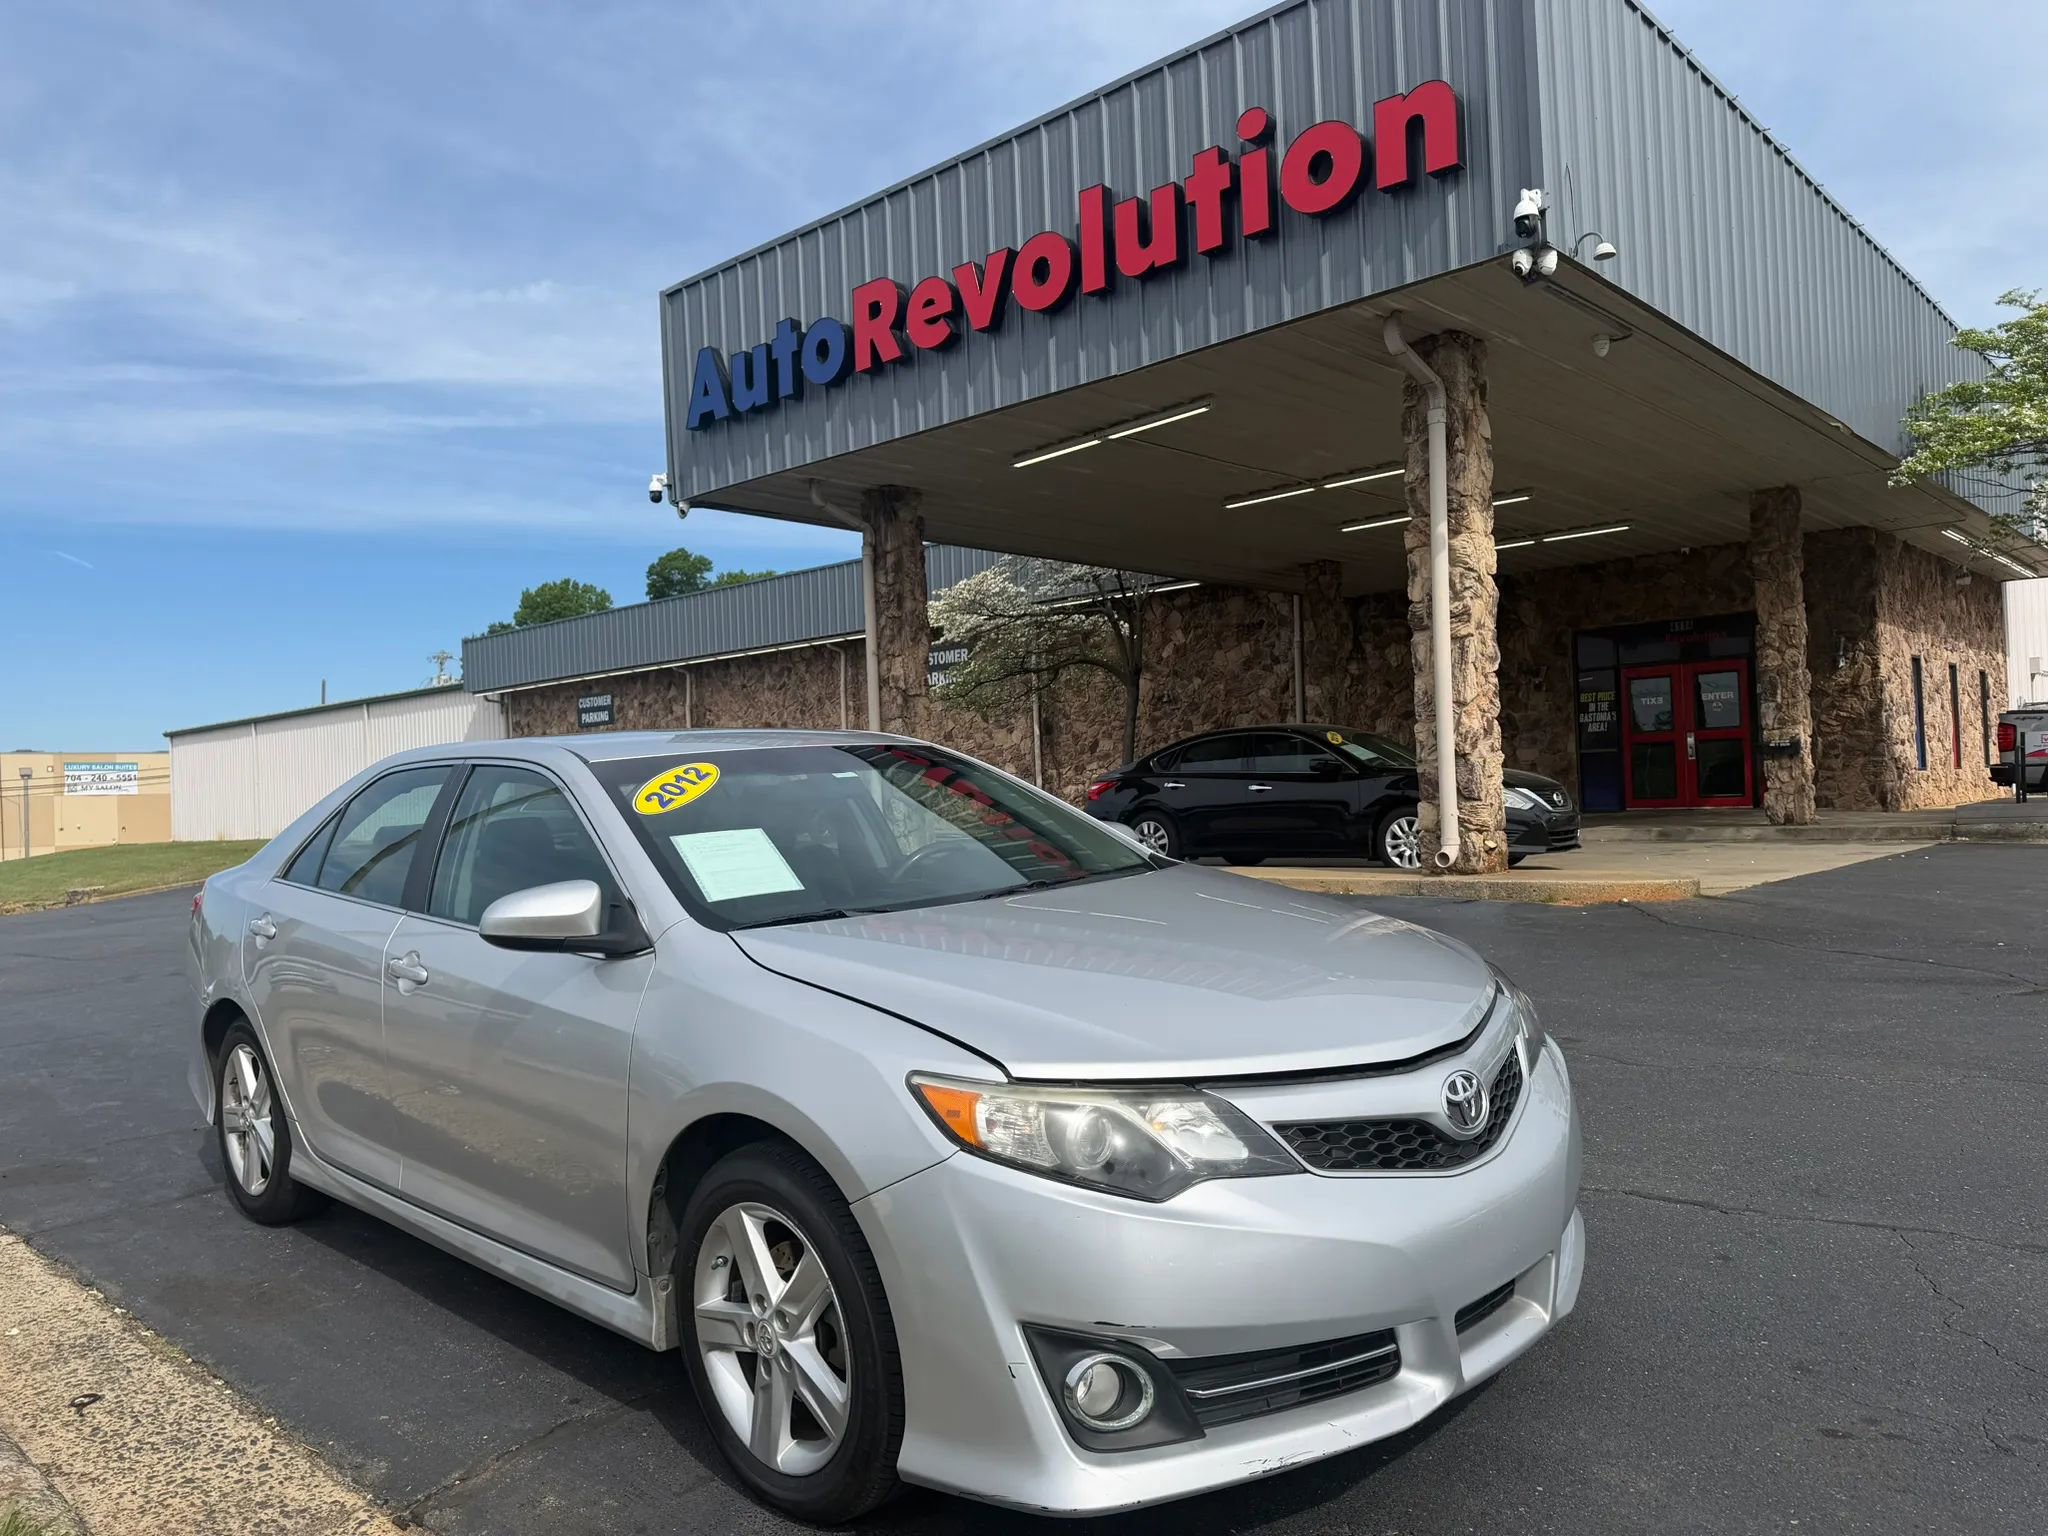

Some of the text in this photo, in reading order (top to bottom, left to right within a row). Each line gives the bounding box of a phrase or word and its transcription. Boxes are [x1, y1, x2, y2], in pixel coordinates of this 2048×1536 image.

[686, 79, 1465, 431] AutoRevolution
[928, 648, 968, 666] STOMER
[578, 694, 612, 709] CUSTOMER
[1579, 690, 1616, 702] BEST PRICE
[1702, 691, 1734, 701] ENTER
[1597, 701, 1609, 712] THE
[581, 710, 610, 724] PARKING
[1587, 721, 1608, 733] AREA!
[65, 774, 82, 782] 704
[91, 774, 108, 782] 240
[645, 767, 712, 809] 2012
